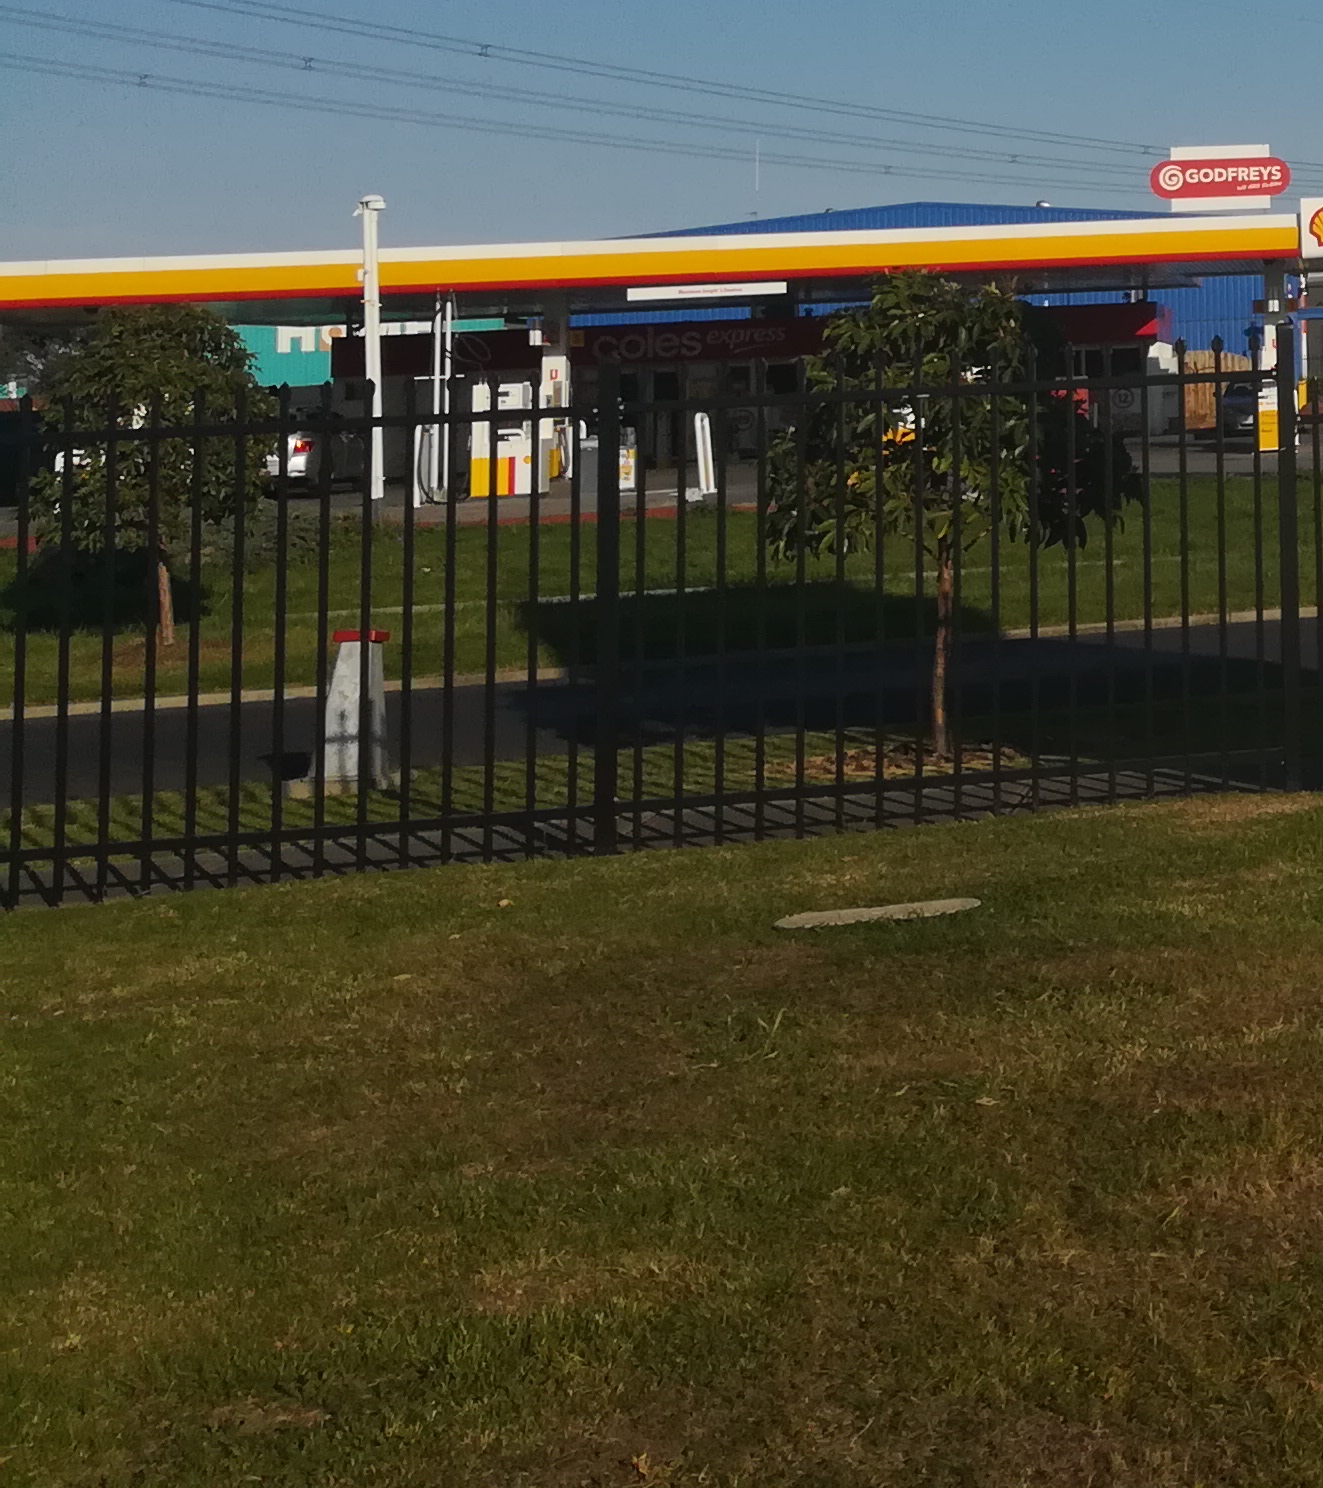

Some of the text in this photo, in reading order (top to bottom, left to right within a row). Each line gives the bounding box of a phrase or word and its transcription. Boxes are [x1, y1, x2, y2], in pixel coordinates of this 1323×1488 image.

[1185, 165, 1282, 184] GODFREYS
[592, 326, 787, 360] coles express
